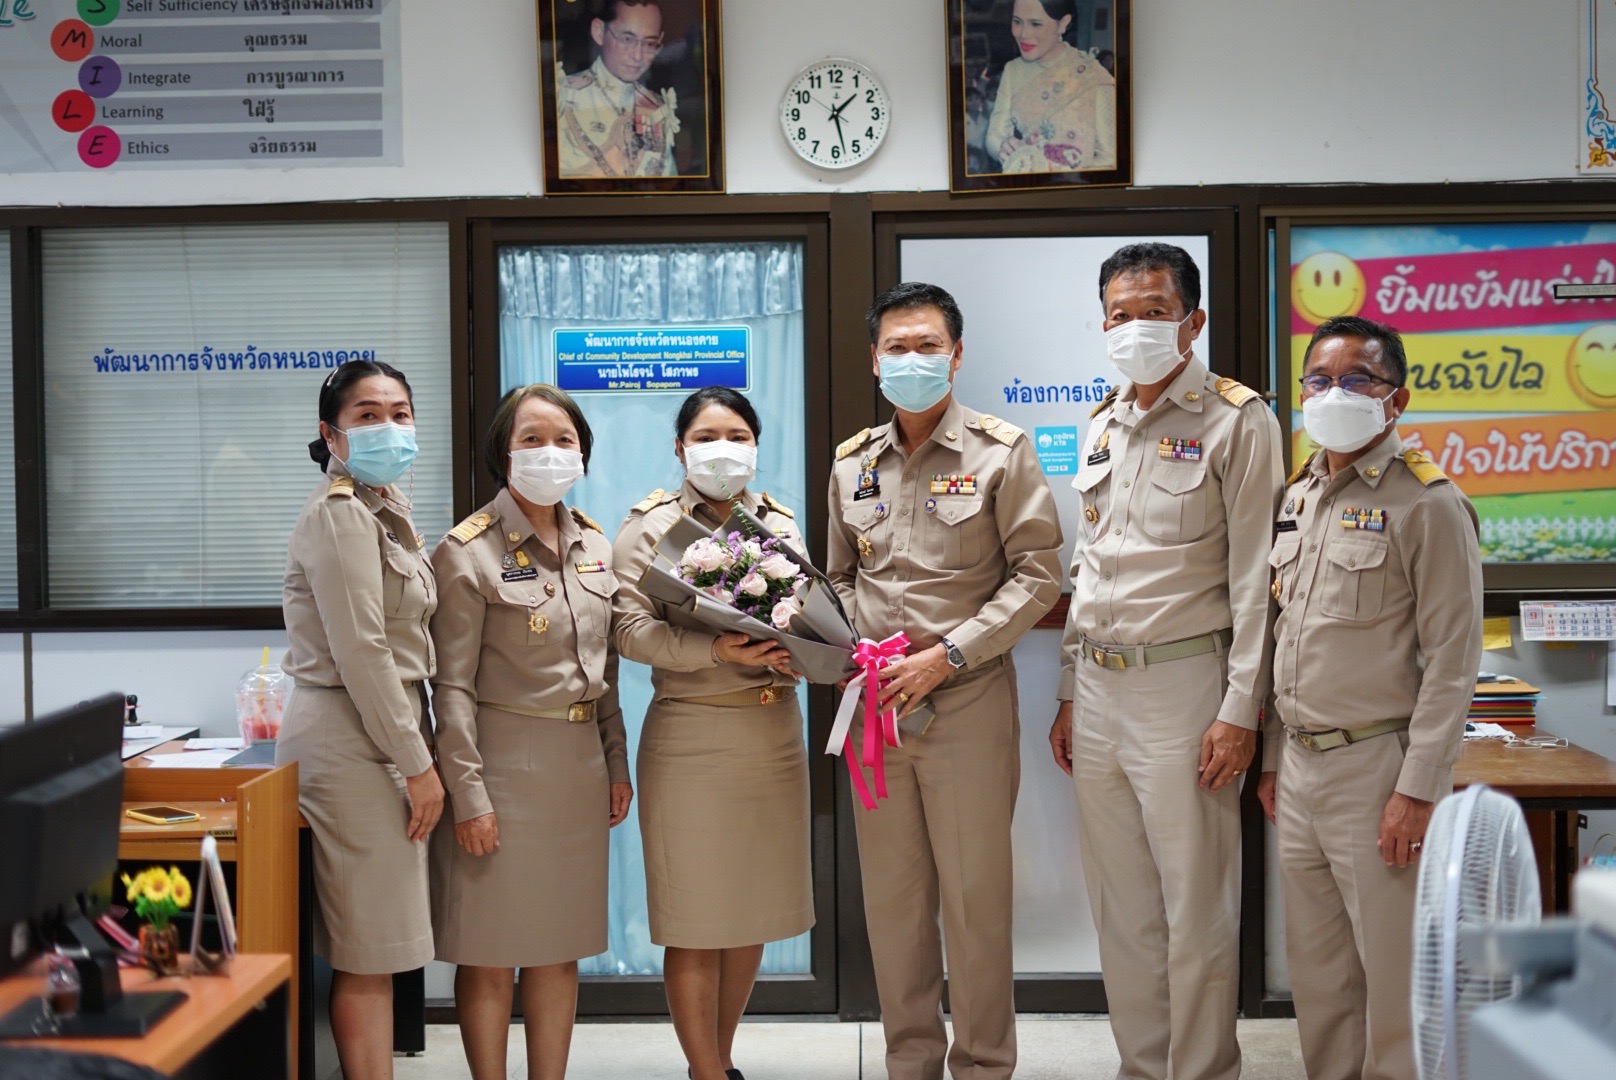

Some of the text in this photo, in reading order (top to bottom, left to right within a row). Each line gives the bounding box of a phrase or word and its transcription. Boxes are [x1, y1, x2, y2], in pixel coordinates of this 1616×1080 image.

[127, 0, 238, 13] Self Sufficiency
[61, 28, 86, 48] M
[100, 33, 142, 48] Moral
[243, 33, 308, 53] คุณธรรม
[89, 66, 104, 86] I
[128, 71, 191, 87] Integrate
[246, 70, 345, 89] การบูรณาการ
[809, 75, 822, 89] 11
[827, 69, 843, 84] 12
[852, 74, 859, 88] 1
[795, 90, 810, 104] 10
[866, 89, 875, 103] 2
[62, 101, 81, 120] L
[102, 105, 164, 120] Learning
[242, 98, 275, 123] ใฝ่รู้
[791, 108, 800, 121] 9
[871, 107, 880, 121] 3
[797, 127, 806, 141] 8
[865, 126, 874, 140] 4
[88, 135, 107, 156] E
[128, 141, 170, 154] Ethics
[249, 136, 317, 154] จริยธรรม
[811, 140, 820, 154] 7
[831, 145, 840, 159] 6
[851, 140, 861, 153] 5
[584, 332, 719, 348] พัฒนาการจังหวัดหนองคาย
[558, 350, 745, 362] Chief of Community Development Nongkhai Provincial Office
[598, 363, 699, 378] นายไพโรจน์ โสภาพร
[1408, 345, 1545, 391] นฉับไว
[646, 381, 681, 389] Sopaporn
